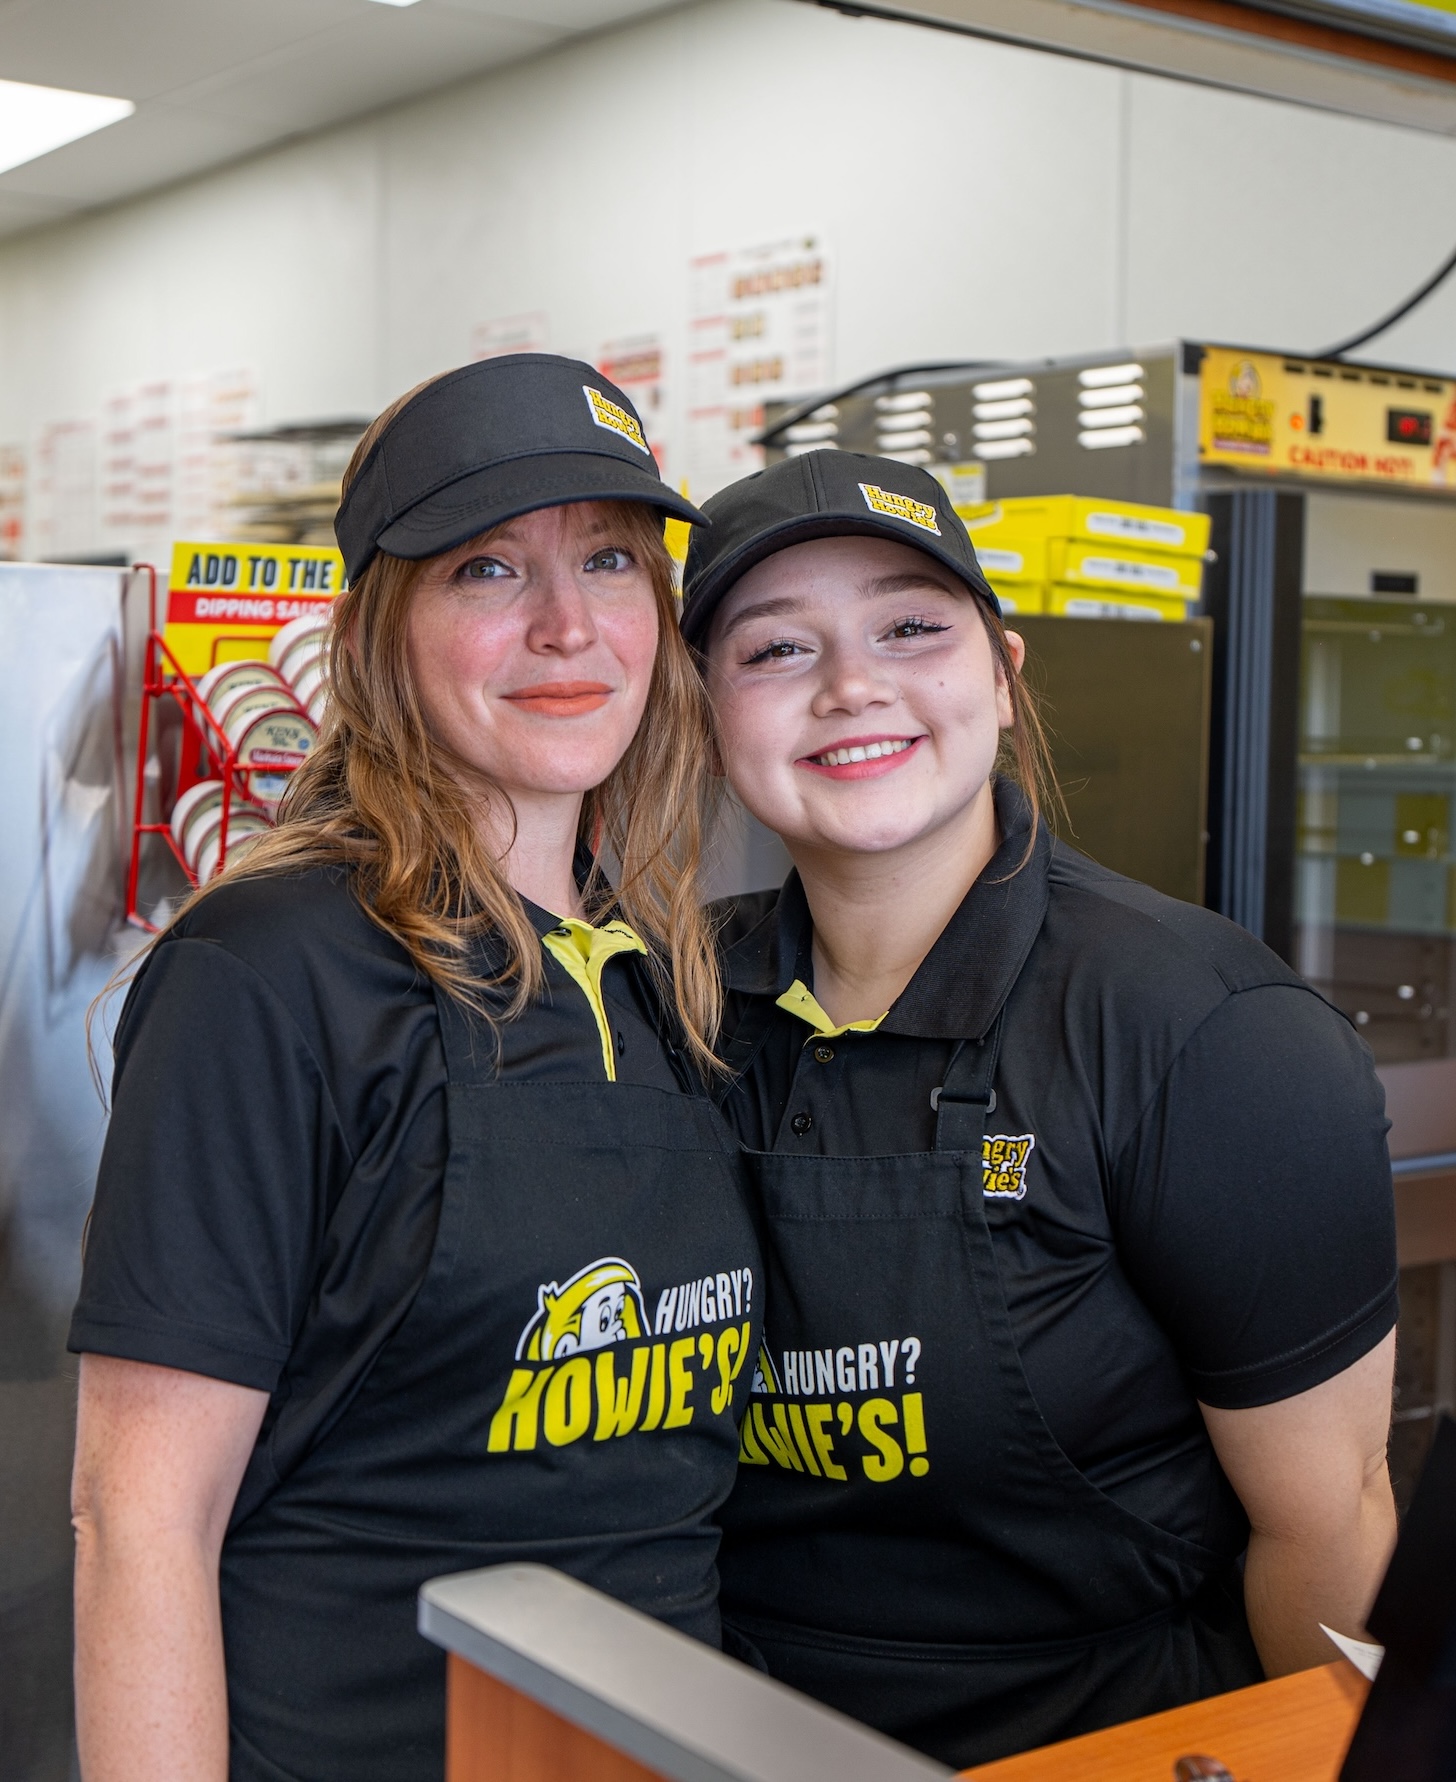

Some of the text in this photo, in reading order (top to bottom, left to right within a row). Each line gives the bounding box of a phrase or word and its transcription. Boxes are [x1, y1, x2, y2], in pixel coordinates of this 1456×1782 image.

[589, 390, 640, 436] Hungry
[864, 485, 934, 520] Hungry
[186, 553, 240, 589] ADD
[248, 555, 281, 590] TO
[288, 558, 335, 592] THE
[195, 597, 274, 619] DIPPING
[654, 1267, 752, 1336] HUNGRY?
[487, 1320, 750, 1452] HOWIE'S!
[783, 1336, 922, 1396] HUNGRY?
